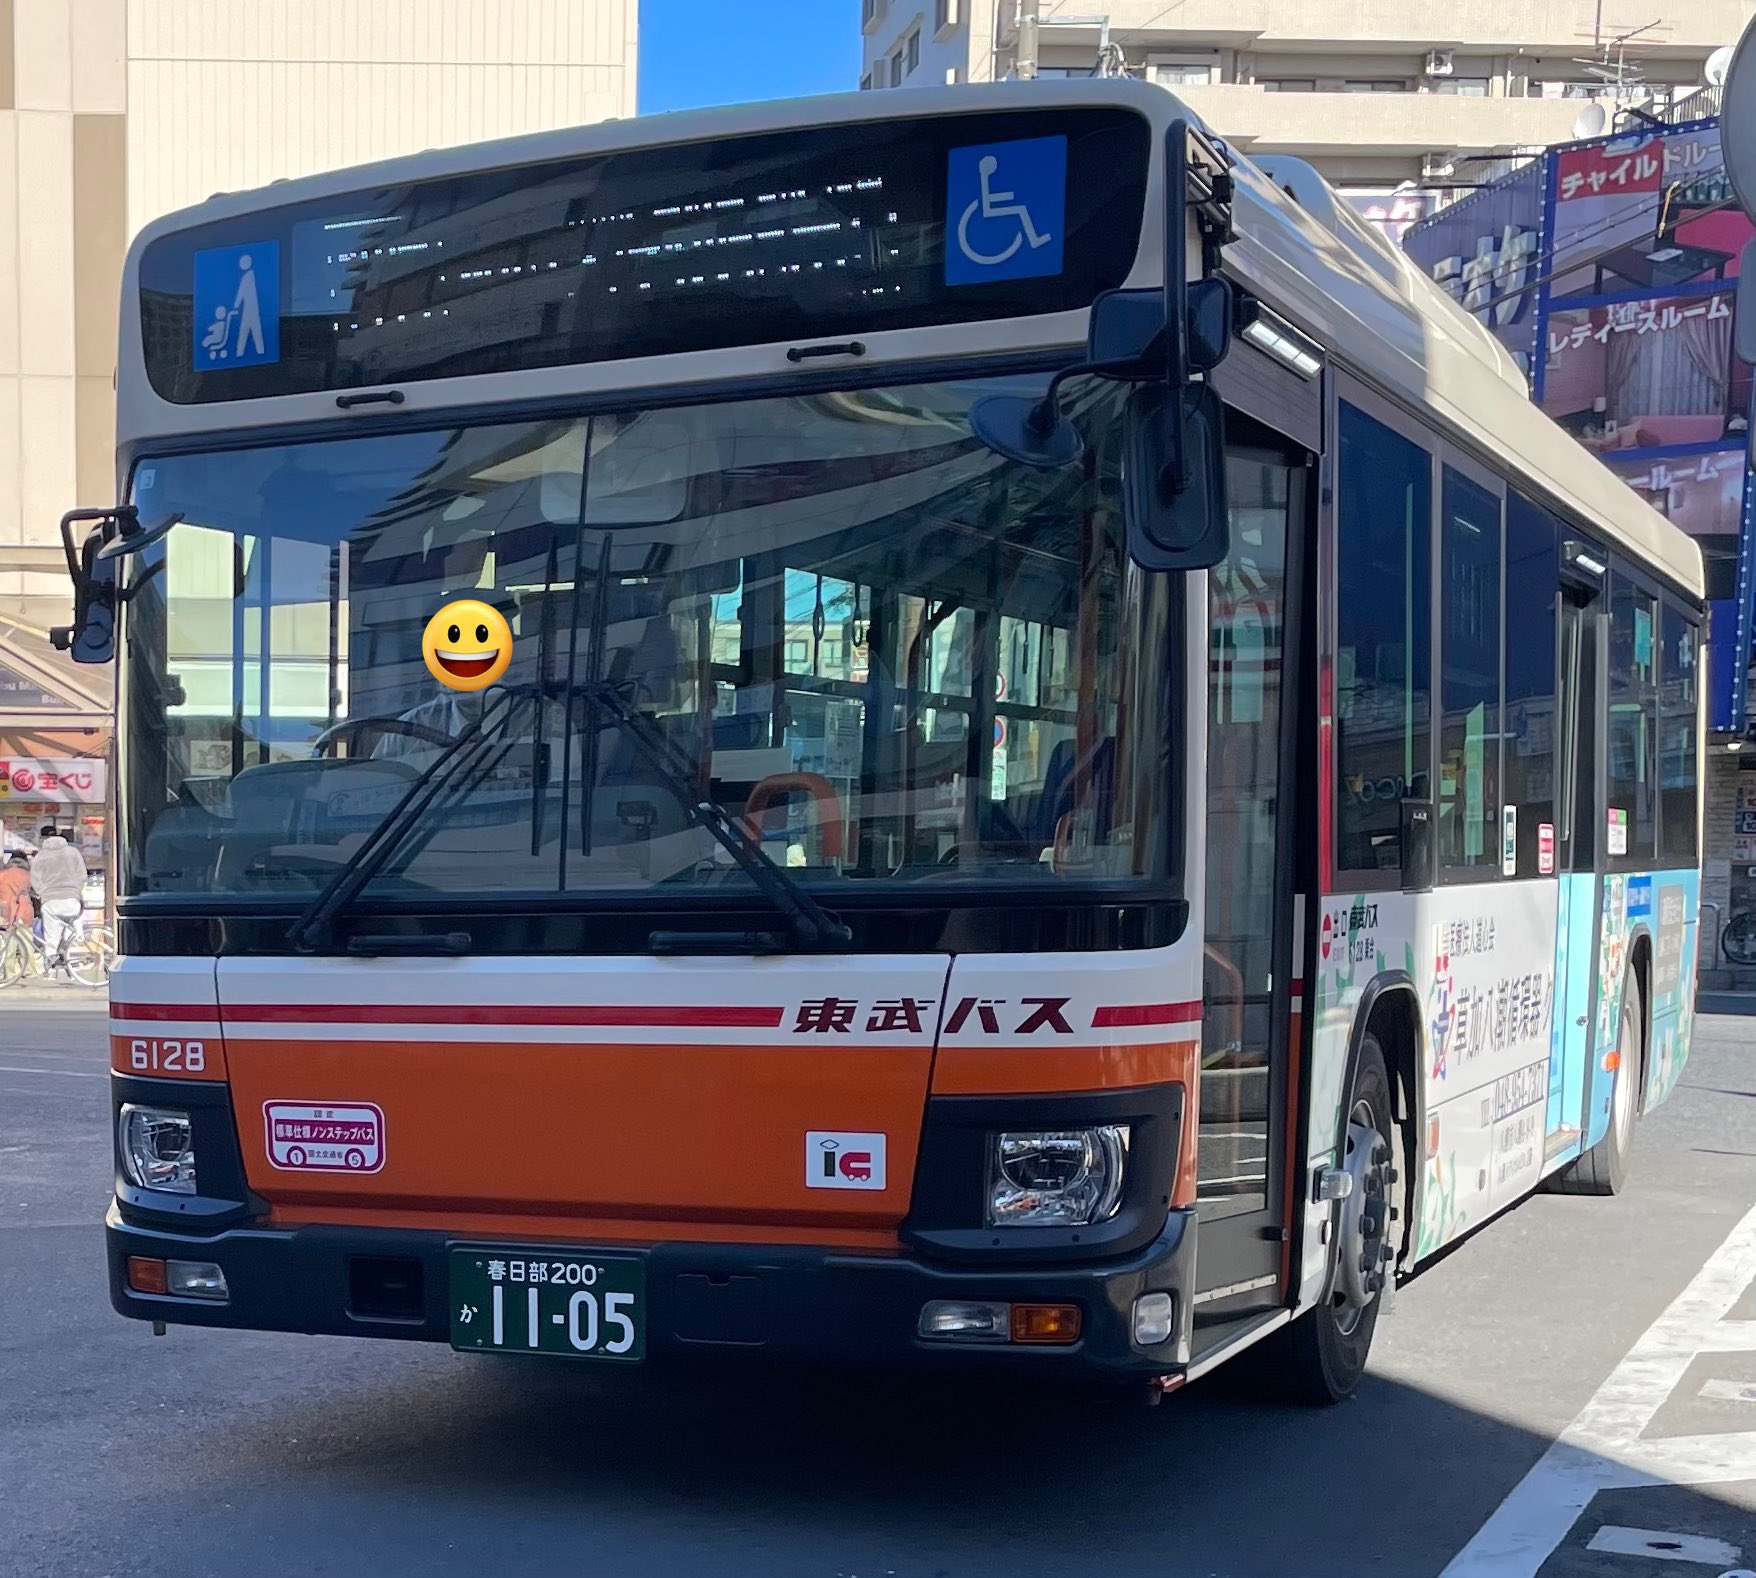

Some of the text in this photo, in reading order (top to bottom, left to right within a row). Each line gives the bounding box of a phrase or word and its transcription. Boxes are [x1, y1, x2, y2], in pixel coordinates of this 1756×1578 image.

[1550, 296, 1730, 354] レディースルーム
[38, 772, 92, 790] 宝くじ
[792, 997, 1074, 1034] 東武バス
[131, 1040, 204, 1072] 6128
[460, 1285, 636, 1354] か 11-05
